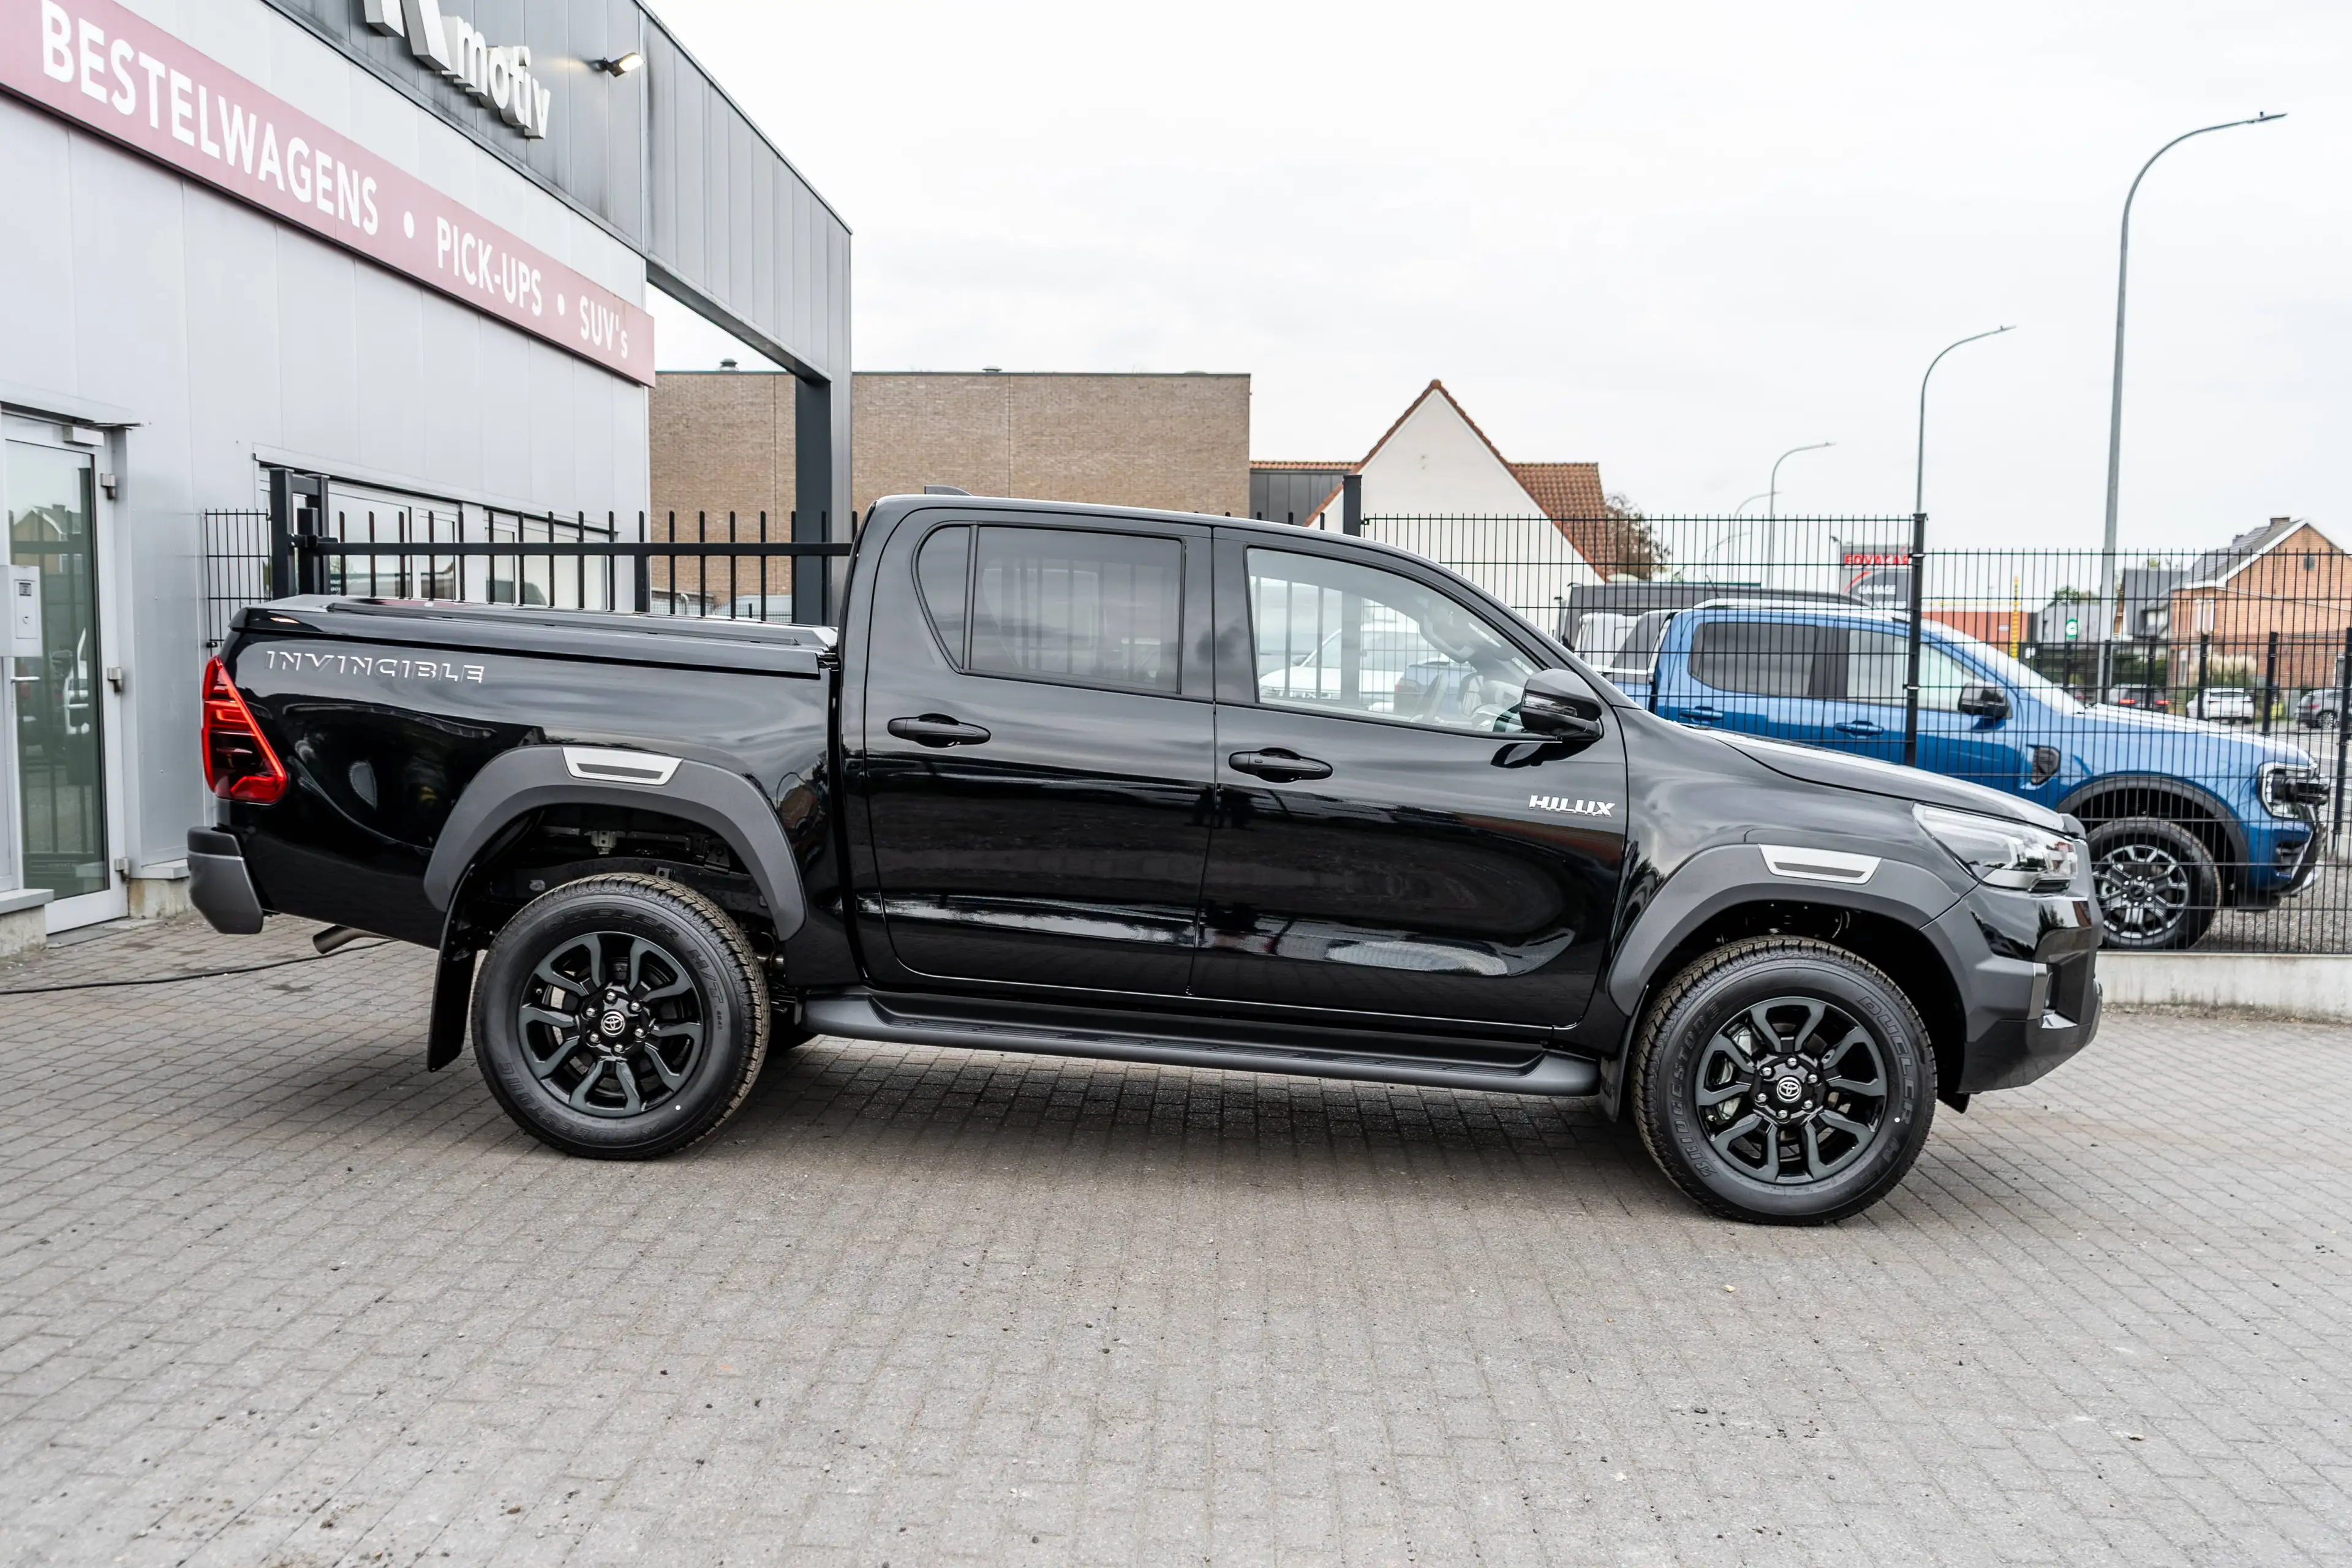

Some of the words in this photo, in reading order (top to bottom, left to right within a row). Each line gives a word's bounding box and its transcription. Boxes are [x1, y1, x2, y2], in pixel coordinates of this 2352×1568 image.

[41, 0, 379, 236] BESTELWAGENS
[437, 216, 542, 317] PICK-UPS
[579, 295, 628, 359] SUV's
[265, 650, 484, 684] INVINCIBLE
[1529, 794, 1615, 818] HILUX
[685, 949, 724, 1003] H/T
[1672, 1001, 1721, 1177] BRIDGESTONE
[1857, 996, 1916, 1125] DUELER
